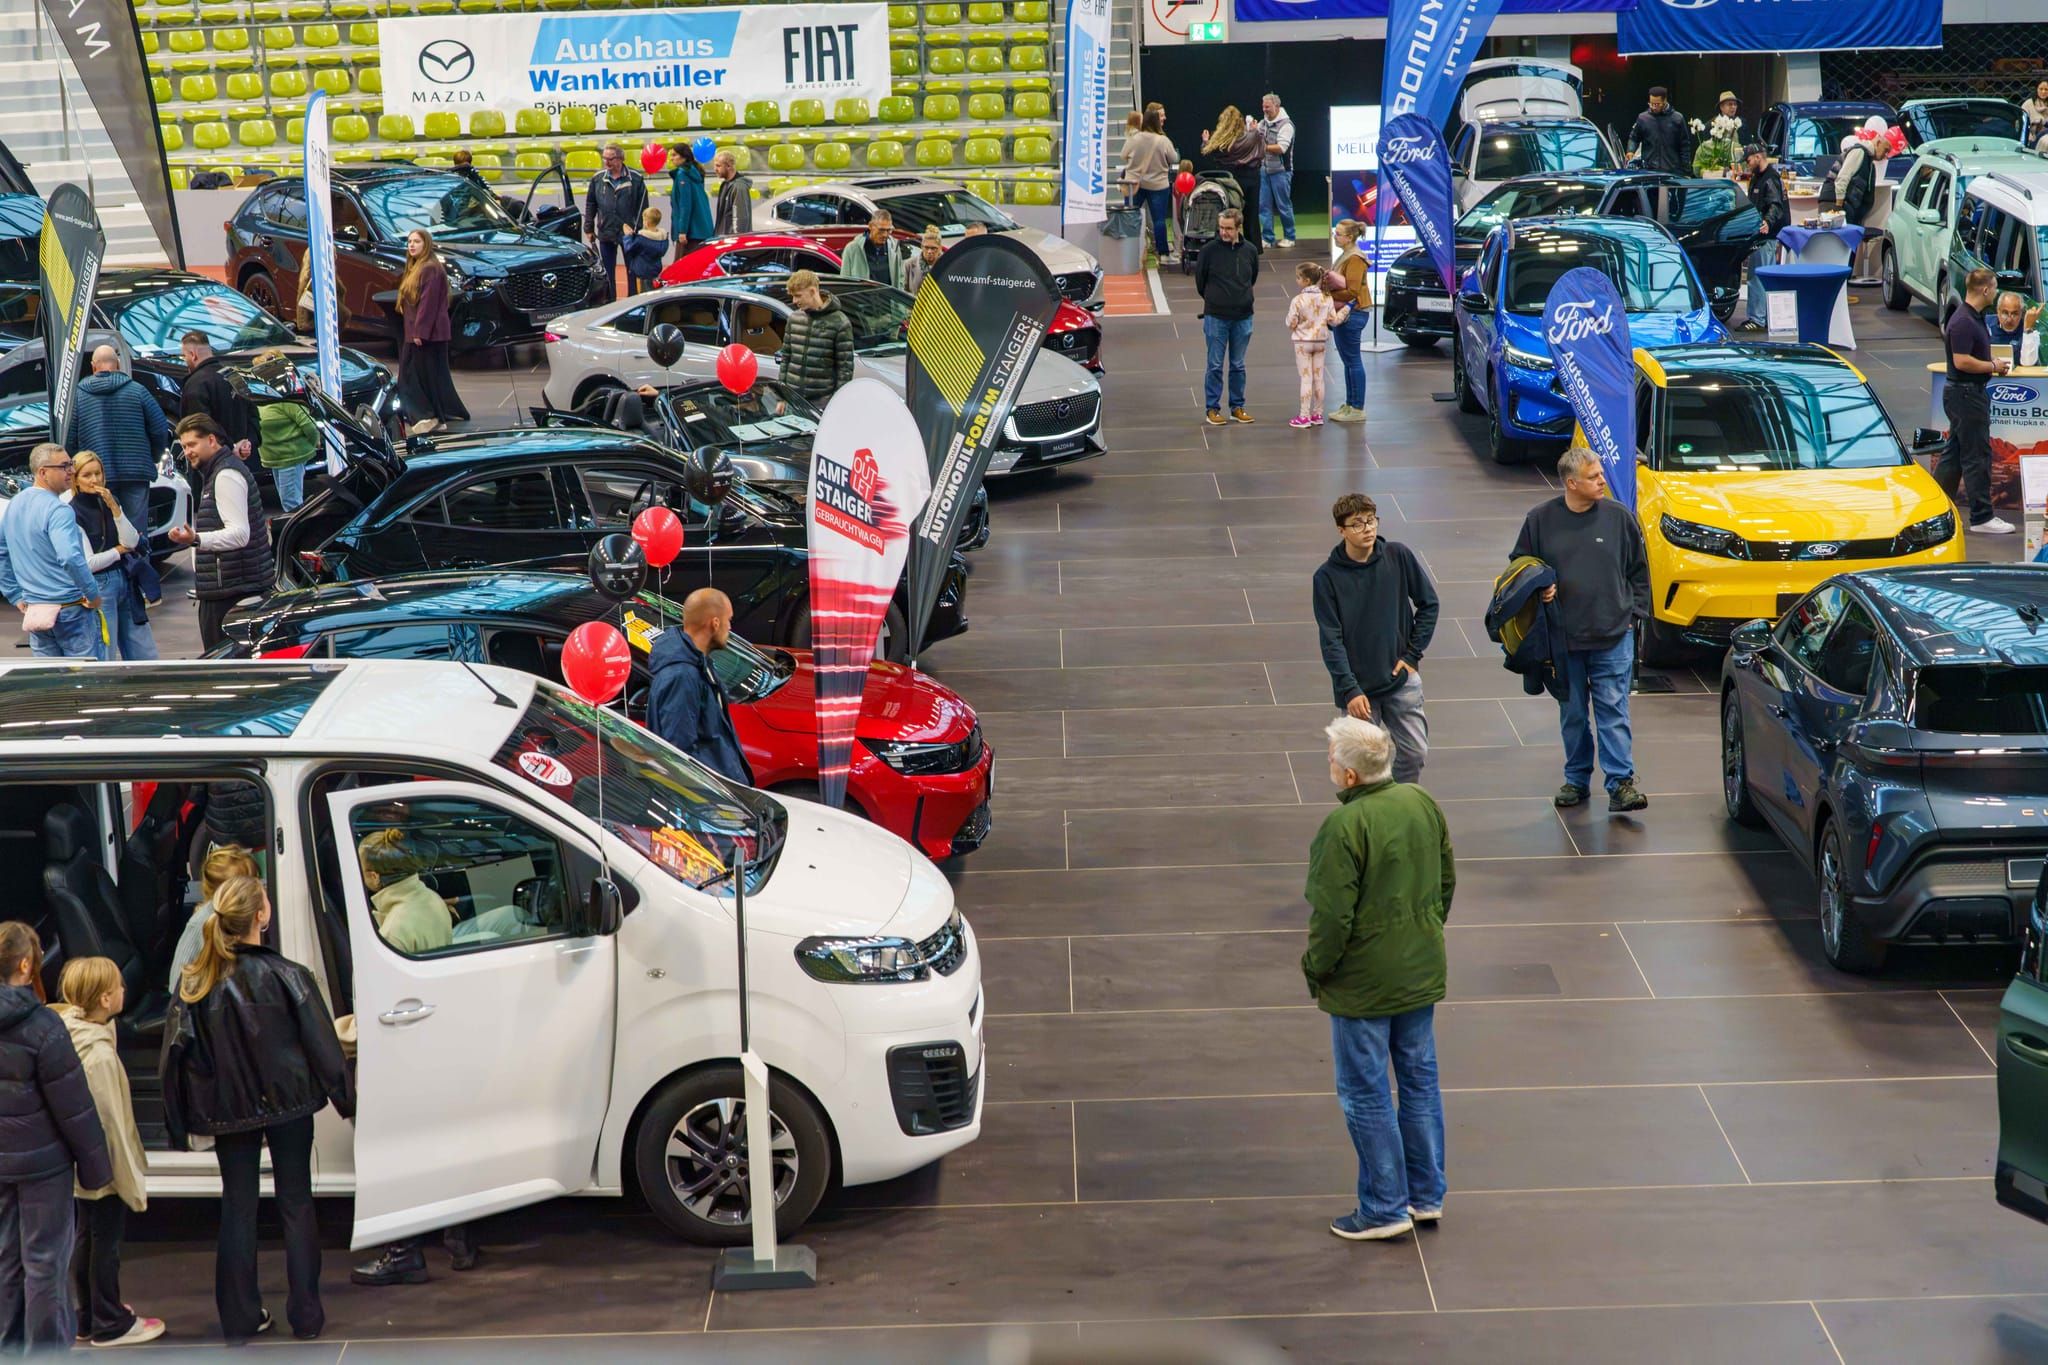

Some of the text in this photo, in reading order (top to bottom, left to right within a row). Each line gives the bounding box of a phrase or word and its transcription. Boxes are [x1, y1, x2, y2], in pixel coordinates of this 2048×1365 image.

[554, 35, 714, 62] Autohaus
[783, 24, 858, 83] FIAT
[528, 64, 727, 93] Wankmüller
[412, 90, 485, 103] MAZDA
[1078, 49, 1093, 172] Autohaus
[1091, 42, 1106, 195] Wankmüller
[1337, 142, 1376, 154] MEILI
[1383, 135, 1436, 165] Ford
[1393, 169, 1428, 223] Autohaus
[1425, 219, 1444, 248] Bolz
[948, 274, 1037, 289] www.amf-staiger.de
[1548, 299, 1613, 345] Ford
[57, 306, 84, 425] AUTOMOBILFORUM
[78, 258, 95, 306] STAIGER
[1561, 350, 1621, 466] Autohaus Bolz
[1992, 385, 2028, 401] Ford
[1567, 383, 1587, 421] Raphael
[1584, 418, 1600, 447] Hupka
[1990, 405, 2028, 417] haus
[929, 387, 1000, 545] AUTOMOBILFORUM
[992, 322, 1031, 388] STAIGER
[817, 458, 849, 488] AMF
[853, 457, 878, 486] OUT
[816, 480, 873, 525] STAIGER
[852, 474, 872, 501] LET
